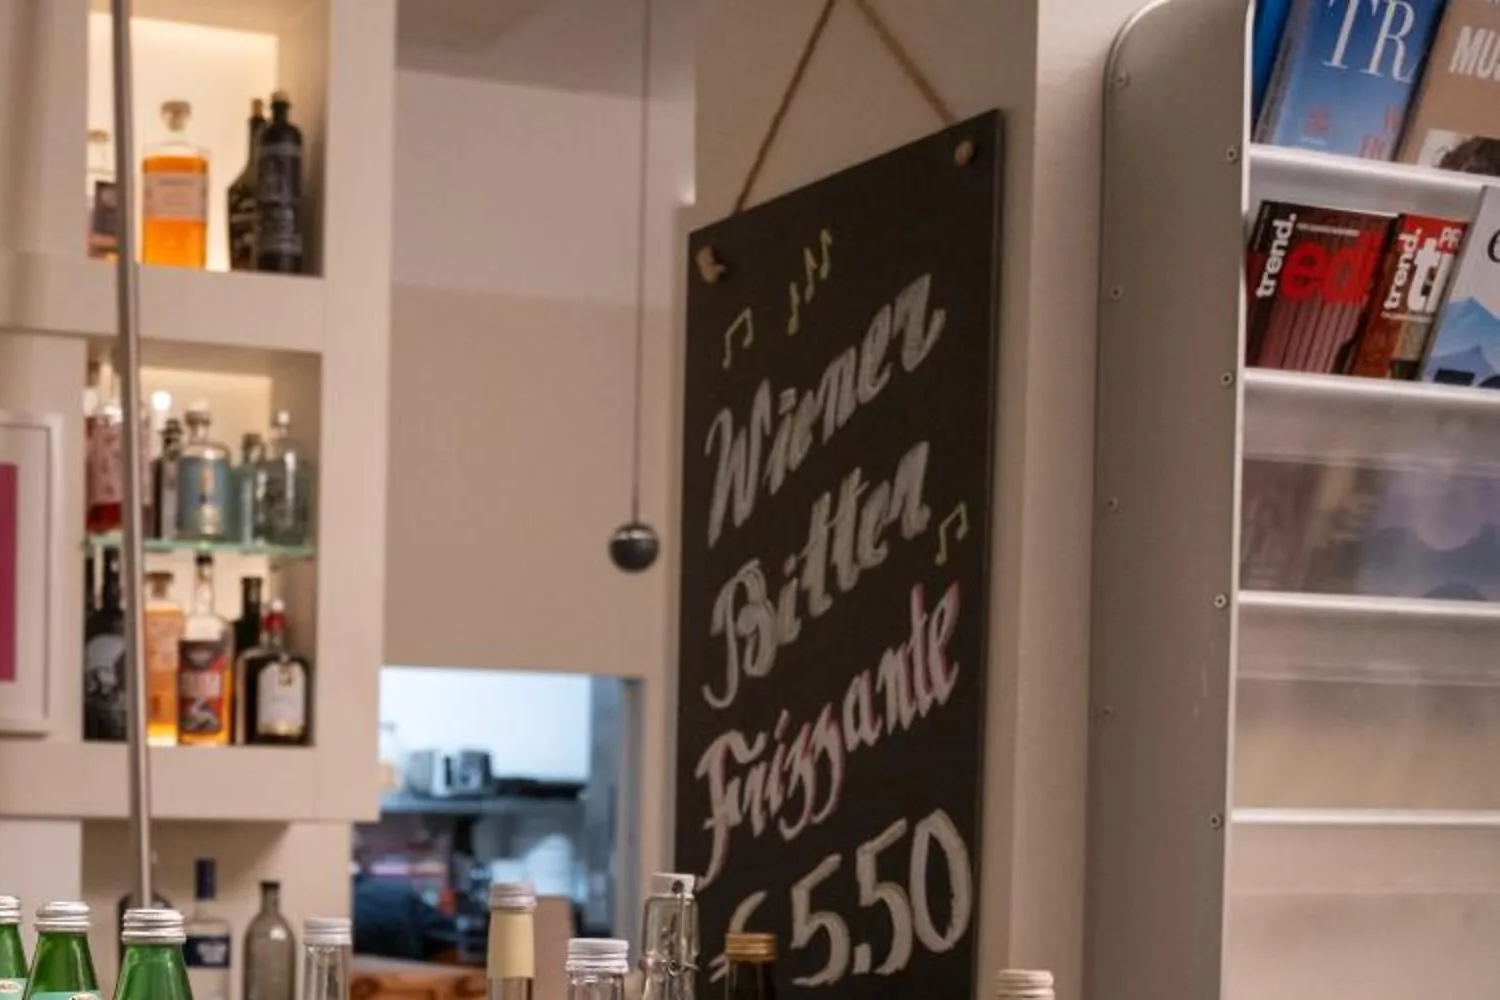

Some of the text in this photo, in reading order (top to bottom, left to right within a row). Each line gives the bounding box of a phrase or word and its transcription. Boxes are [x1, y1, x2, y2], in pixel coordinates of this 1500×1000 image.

[1256, 213, 1297, 298] trend.
[1384, 228, 1422, 310] trend.
[704, 271, 947, 550] Wiener
[701, 440, 932, 710] Bitter
[695, 581, 960, 893] Frizzante
